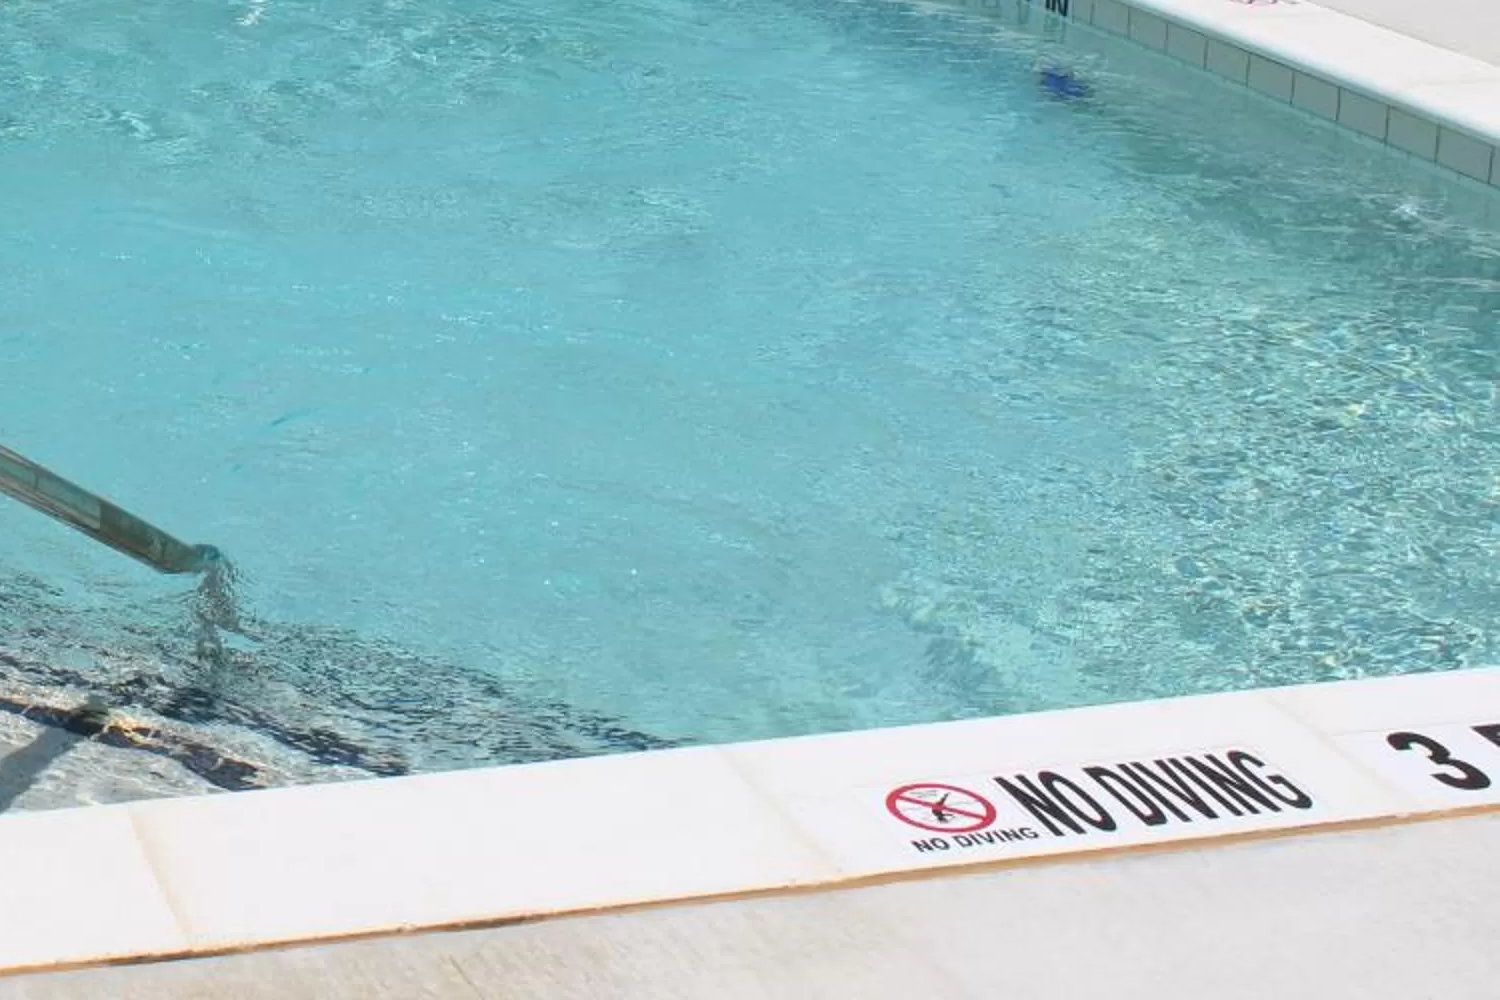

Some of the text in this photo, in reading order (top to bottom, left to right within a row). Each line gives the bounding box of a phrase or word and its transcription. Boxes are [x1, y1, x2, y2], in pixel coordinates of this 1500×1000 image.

[1386, 731, 1491, 790] 3
[991, 749, 1313, 837] NO DIVING
[911, 827, 1039, 853] NO DIVING
